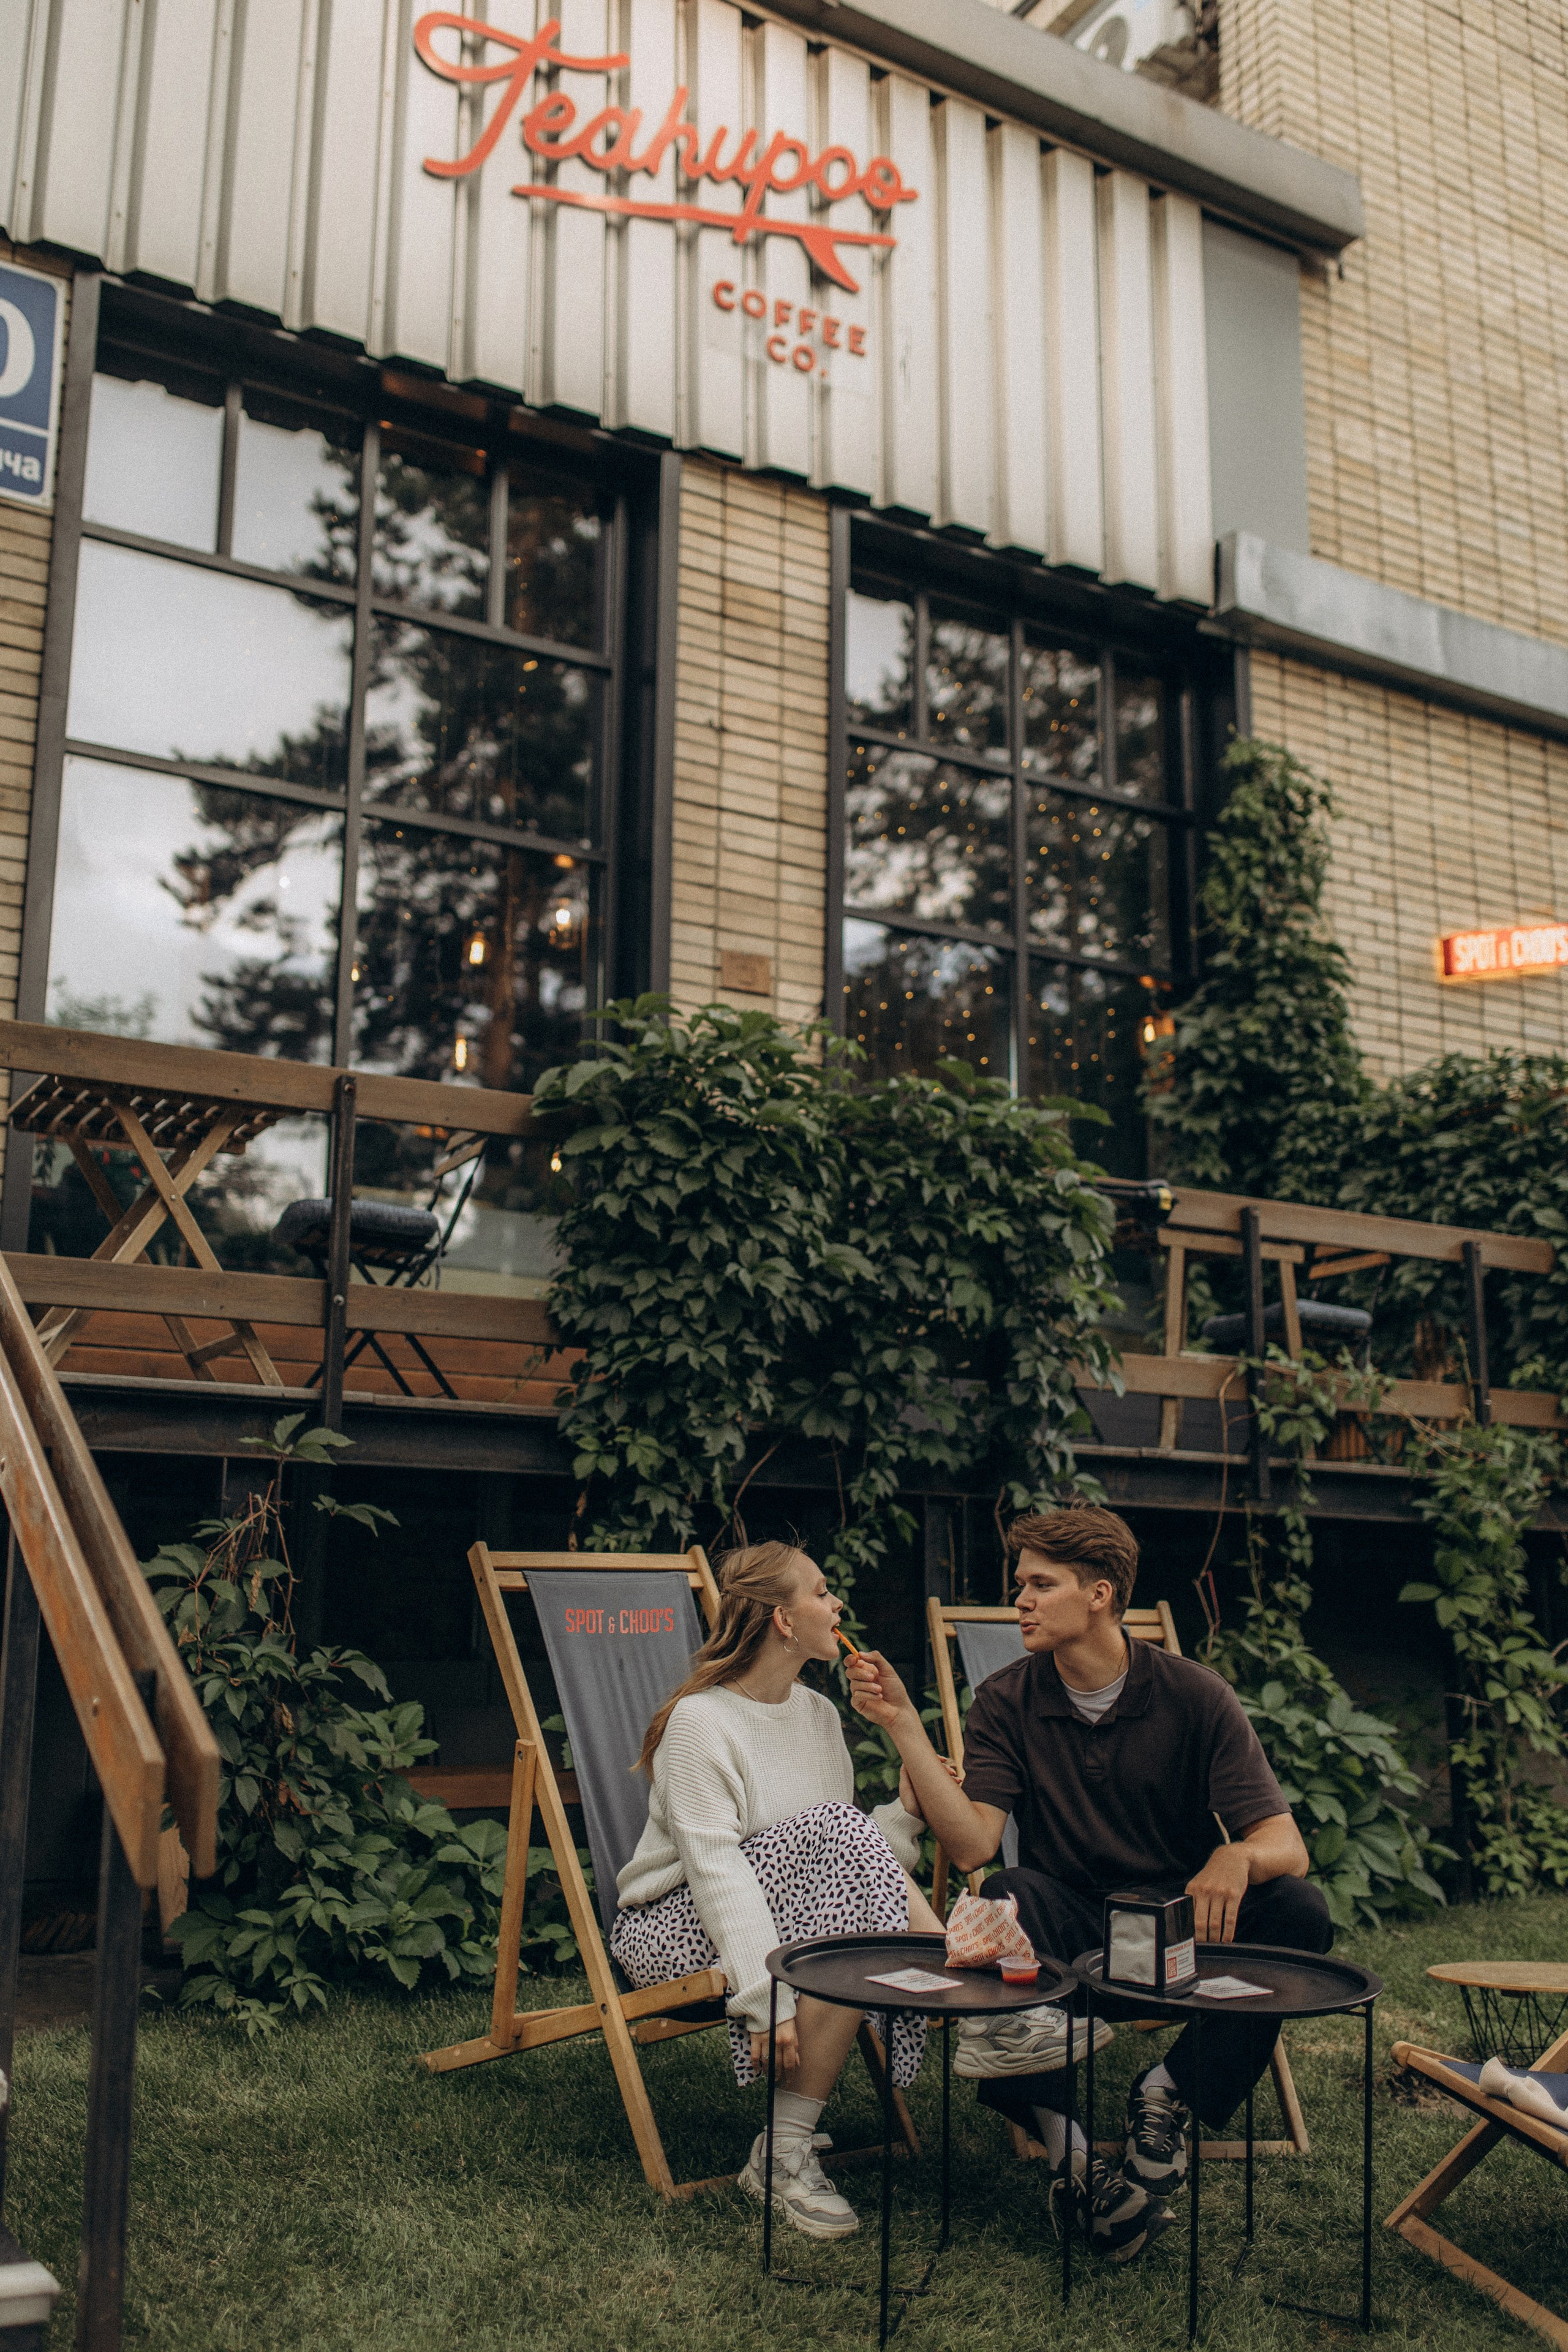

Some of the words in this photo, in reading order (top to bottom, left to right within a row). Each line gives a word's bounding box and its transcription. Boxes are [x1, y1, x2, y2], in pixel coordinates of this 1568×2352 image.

[413, 12, 918, 243] Teahupoo
[714, 280, 866, 356] COFFEE
[767, 335, 826, 377] CO.
[0, 448, 40, 483] ча
[1454, 933, 1496, 972] SPOT
[565, 1608, 605, 1634] SPOT
[608, 1616, 615, 1634] &
[620, 1608, 674, 1634] CHOO'S
[955, 1933, 968, 1943] SPOT
[984, 1913, 995, 1926] SPOT
[960, 1941, 979, 1956] CHOO'S
[982, 1933, 993, 1945] SPOT
[992, 1919, 1009, 1938] CHOO'S
[1005, 1927, 1016, 1943] SPOT
